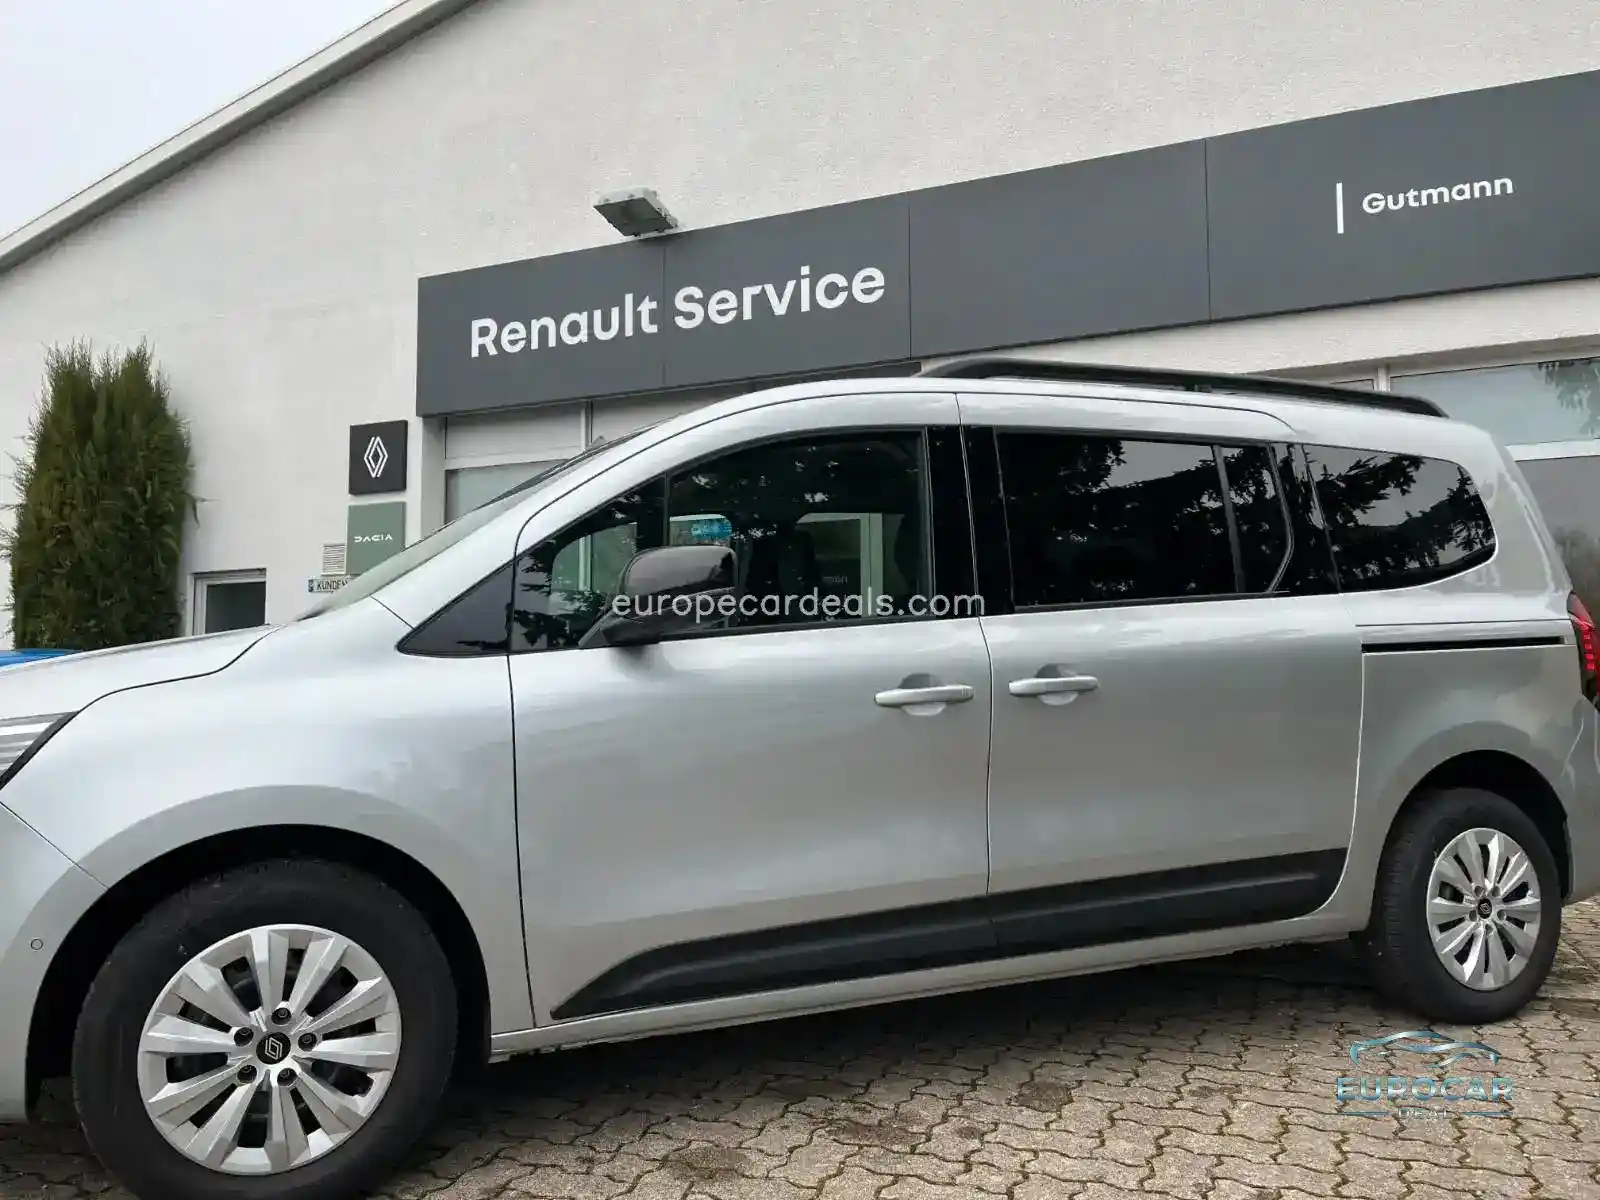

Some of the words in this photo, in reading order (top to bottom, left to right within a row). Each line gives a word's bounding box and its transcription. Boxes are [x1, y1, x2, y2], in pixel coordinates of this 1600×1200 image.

[1362, 178, 1513, 213] Gutmann
[471, 293, 657, 357] Renault
[675, 266, 884, 328] Service
[354, 534, 392, 542] DACIA
